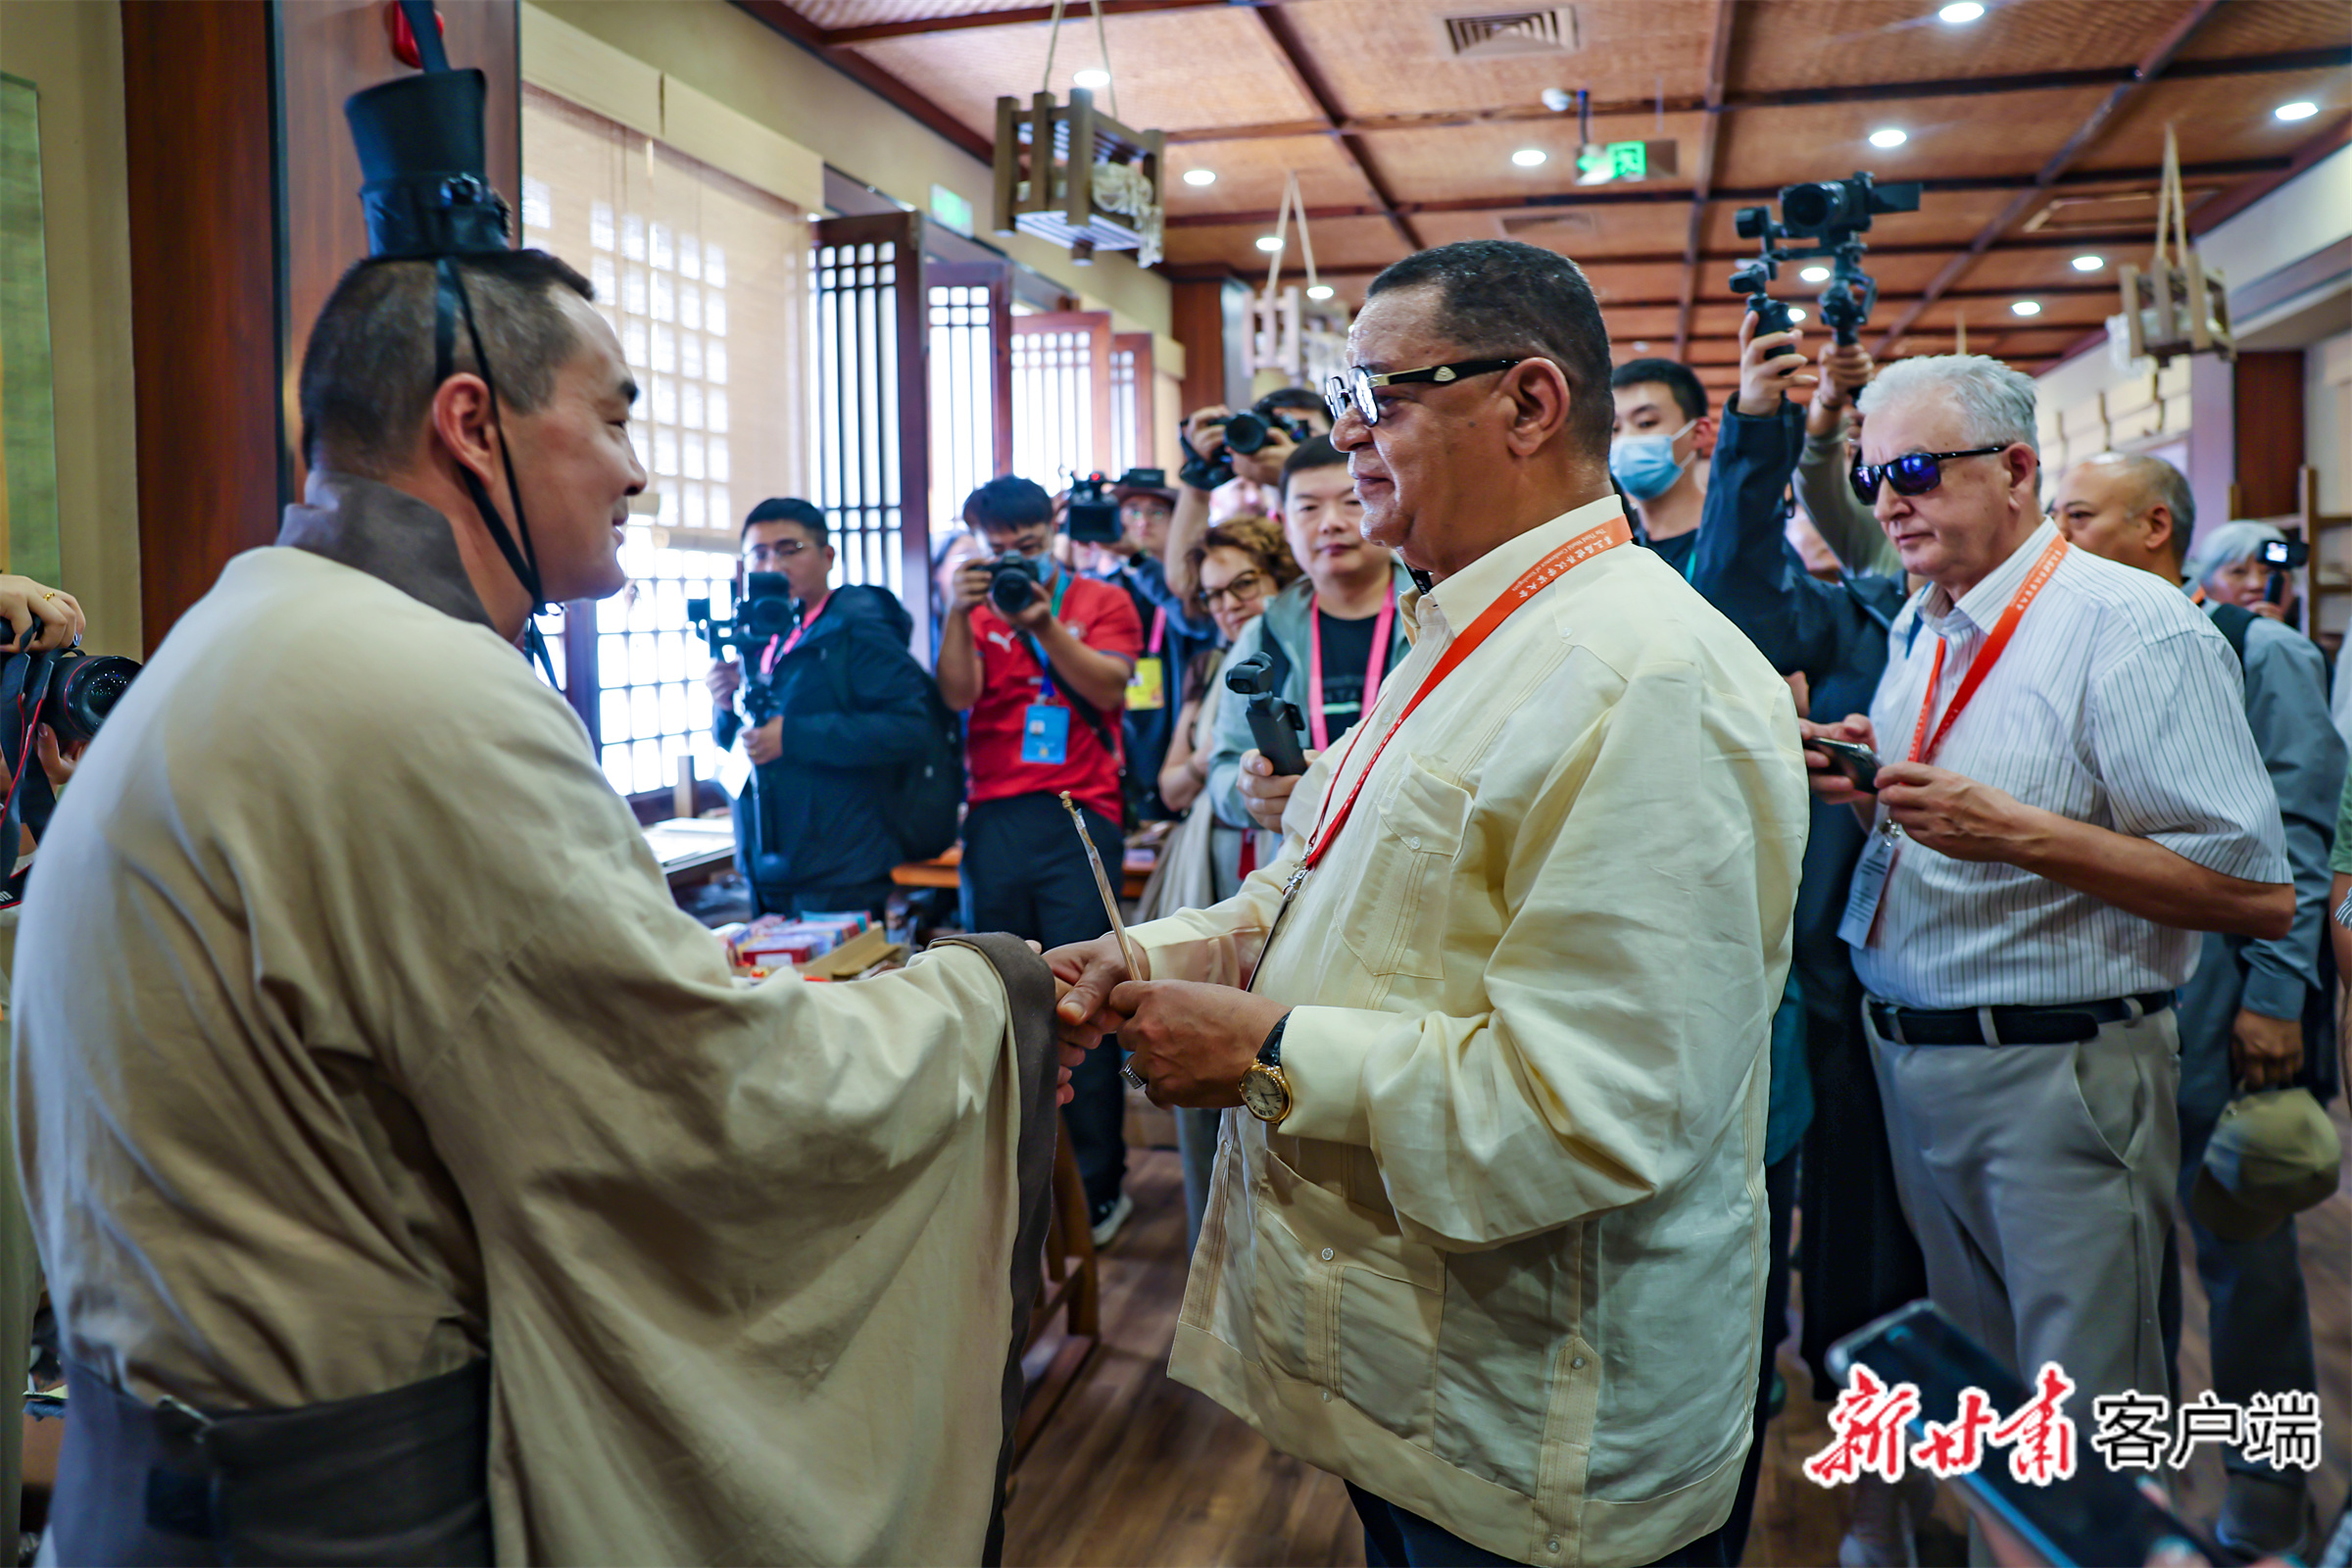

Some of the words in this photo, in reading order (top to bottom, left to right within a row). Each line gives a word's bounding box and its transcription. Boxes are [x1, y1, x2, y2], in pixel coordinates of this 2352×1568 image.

[1566, 539, 1584, 551] World
[1581, 532, 1597, 543] Third
[1519, 536, 1613, 598] 第三届世界汉学家大会
[1541, 548, 1568, 567] Conference
[1511, 570, 1537, 591] Sinologists
